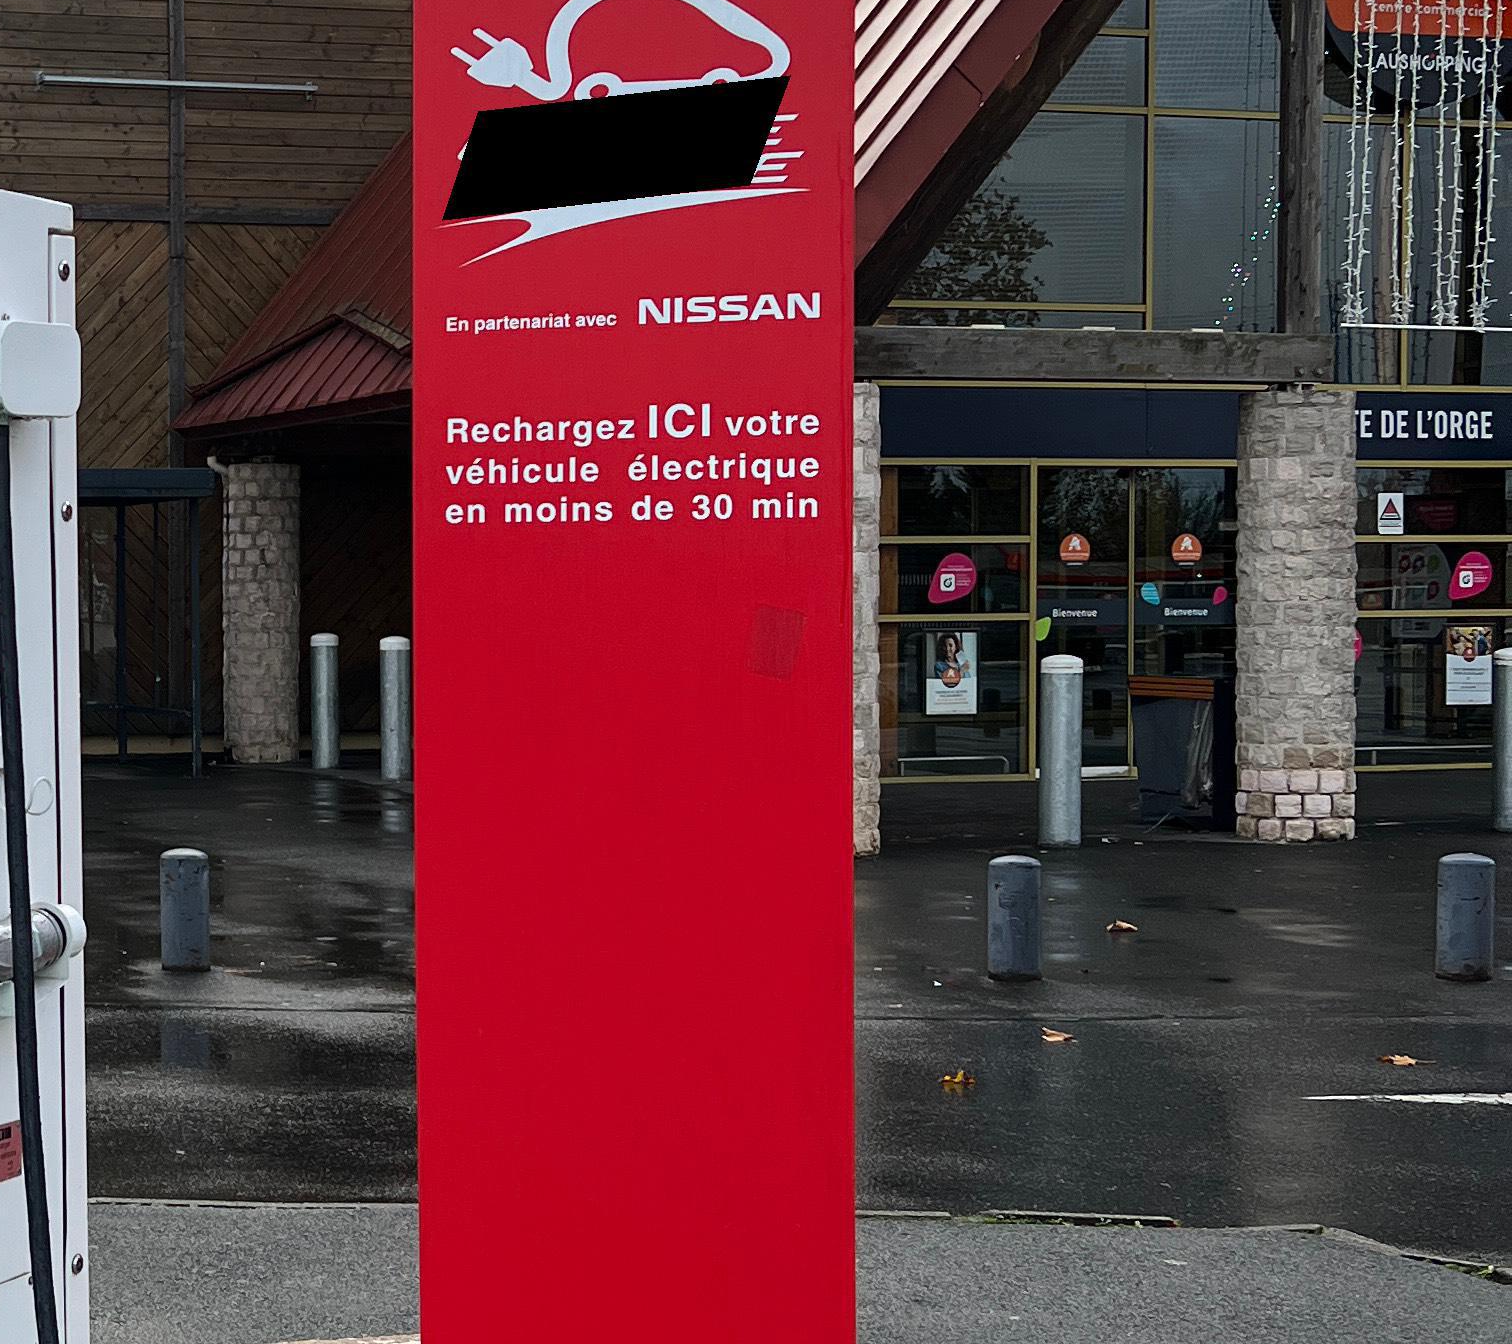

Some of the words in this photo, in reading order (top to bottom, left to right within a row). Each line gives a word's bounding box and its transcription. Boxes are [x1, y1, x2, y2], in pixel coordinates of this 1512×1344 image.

[1417, 4, 1489, 17] commercia
[1375, 52, 1487, 74] AUSHOPPING
[446, 316, 469, 332] En
[474, 313, 571, 335] partenariat
[575, 314, 617, 328] avec
[638, 292, 821, 325] NISSAN
[447, 416, 635, 448] Rechargez
[648, 403, 711, 439] ICI
[724, 410, 820, 436] votre
[1380, 410, 1409, 439] DE
[1416, 410, 1494, 439] L'ORGE
[445, 456, 599, 485] véhicule
[627, 452, 820, 486] électrique
[445, 503, 486, 524] en
[504, 496, 613, 523] moins
[631, 494, 674, 521] de
[691, 493, 733, 520] 30
[752, 490, 818, 519] min
[1052, 608, 1098, 618] Bienvenue
[1164, 607, 1209, 617] Bienvenue
